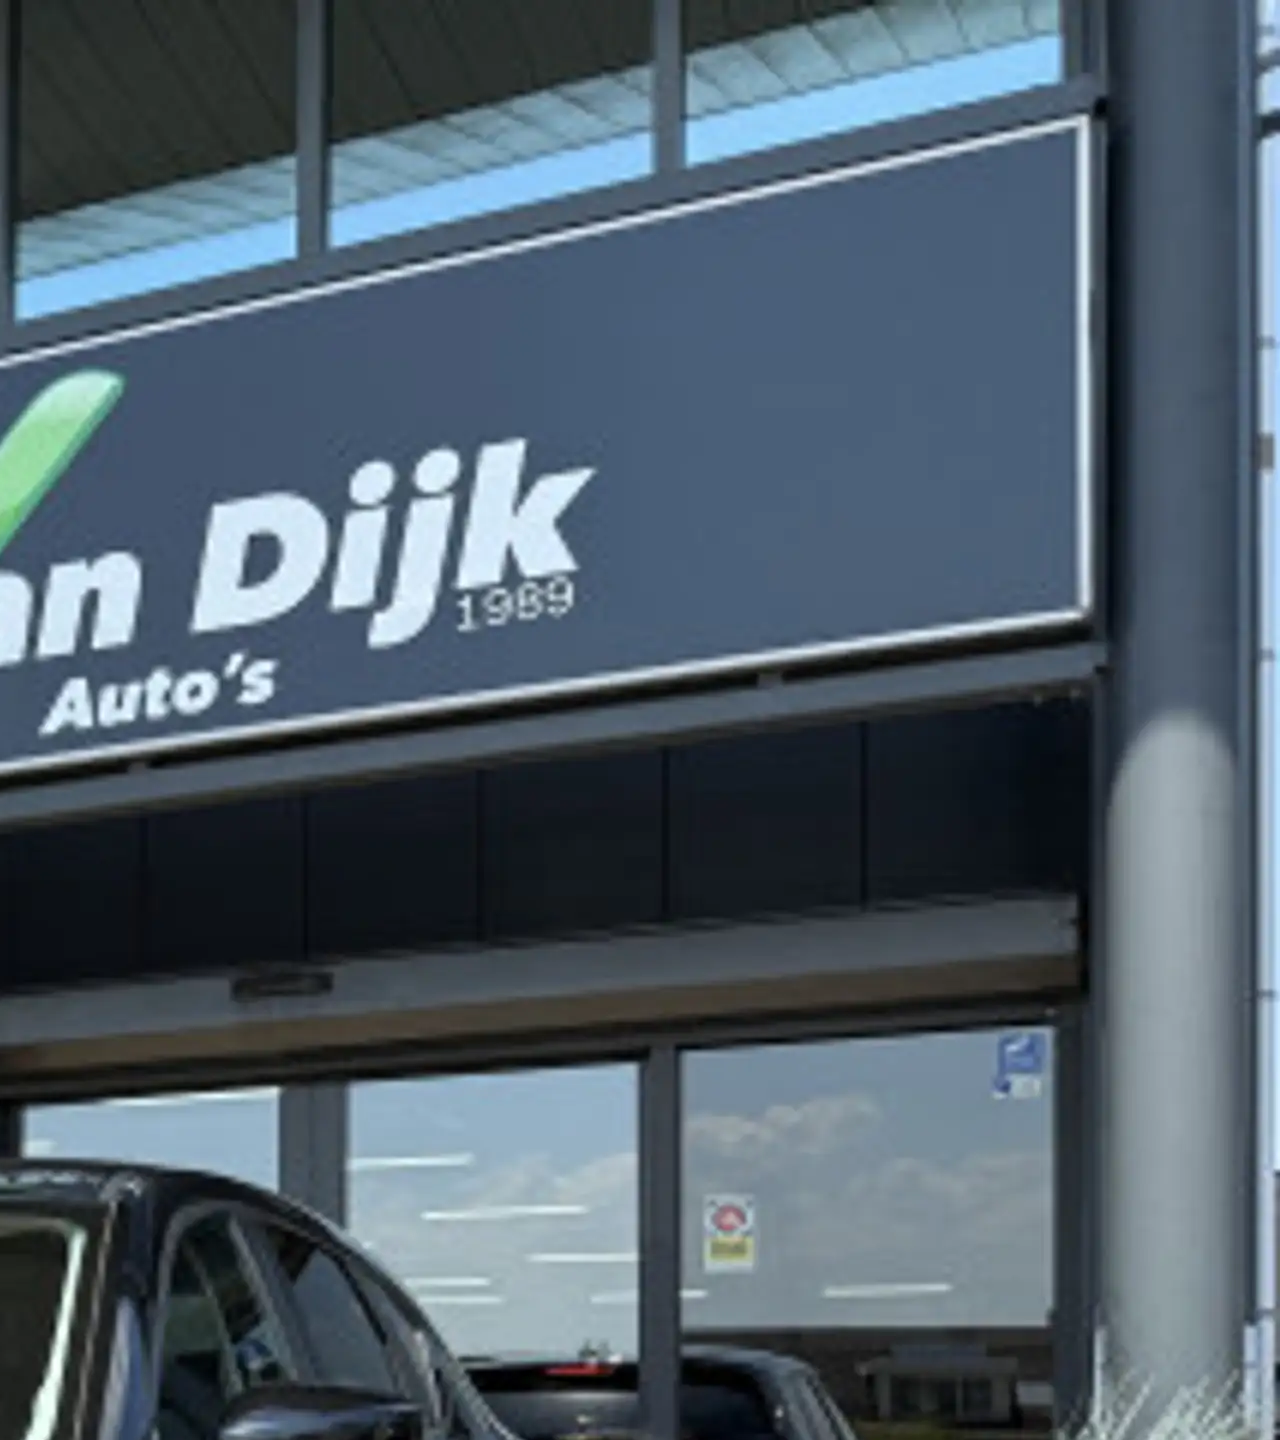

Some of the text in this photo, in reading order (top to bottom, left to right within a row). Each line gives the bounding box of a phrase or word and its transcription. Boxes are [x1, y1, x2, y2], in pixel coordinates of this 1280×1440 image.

[191, 437, 598, 651] Dijk
[456, 575, 575, 633] 1989
[38, 652, 279, 736] Auto's
